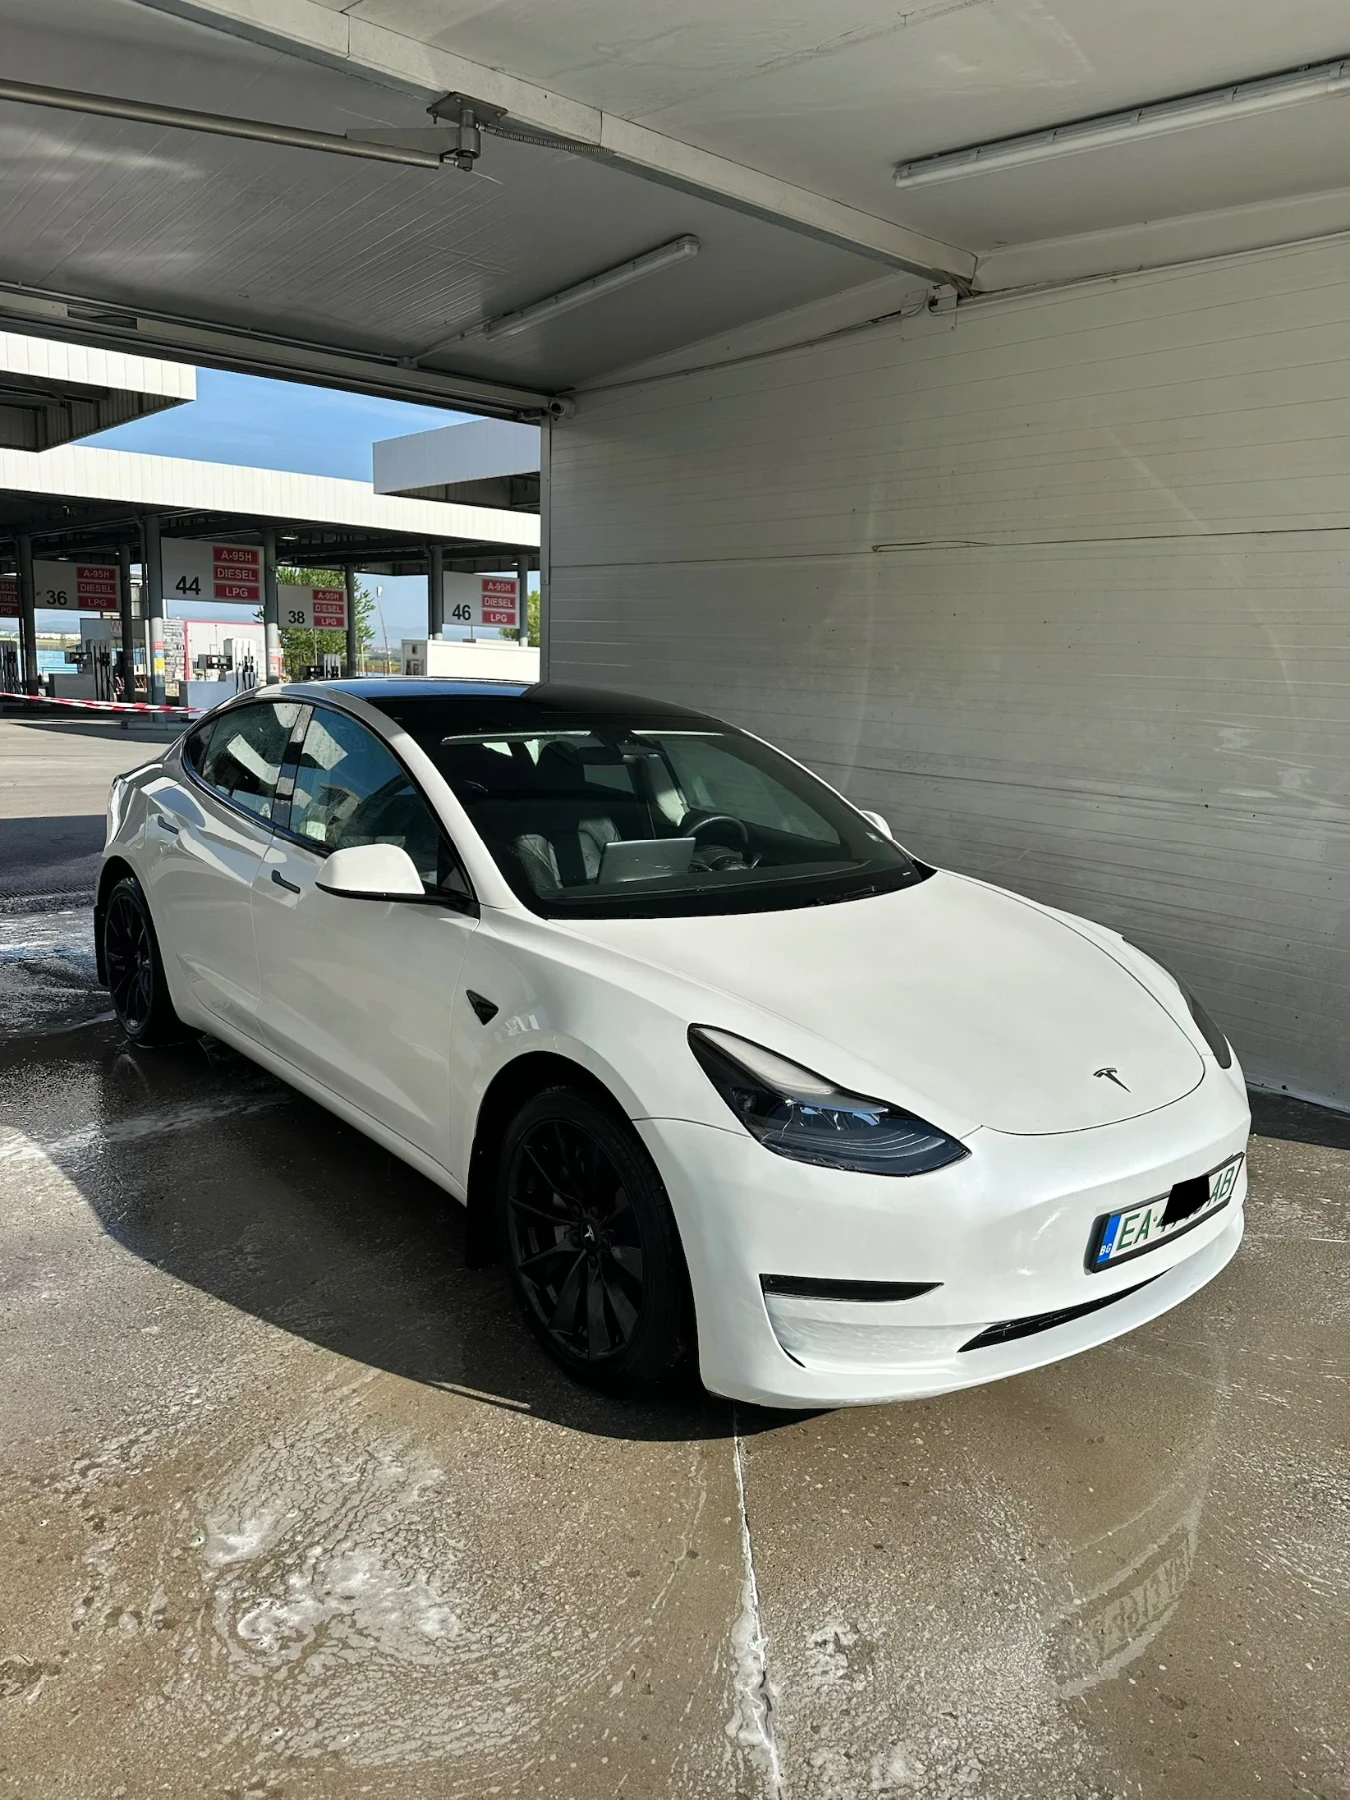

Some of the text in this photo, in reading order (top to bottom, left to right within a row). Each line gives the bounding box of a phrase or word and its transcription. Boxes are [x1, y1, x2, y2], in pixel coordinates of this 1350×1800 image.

[221, 550, 252, 562] A-95H
[83, 569, 110, 579] A-95H
[217, 568, 256, 580] DIESEL
[80, 583, 113, 593] DIESEL
[175, 575, 202, 596] 44
[487, 581, 511, 592] A-95H
[225, 587, 249, 597] LPG
[46, 590, 68, 606] 36
[88, 598, 107, 607] LPG
[484, 597, 513, 608] DIESEL
[315, 604, 342, 613] DIESEL
[451, 603, 472, 621] 46
[288, 610, 306, 624] 38
[321, 618, 337, 626] LPG
[490, 613, 508, 623] LPG
[1099, 1243, 1113, 1256] BG
